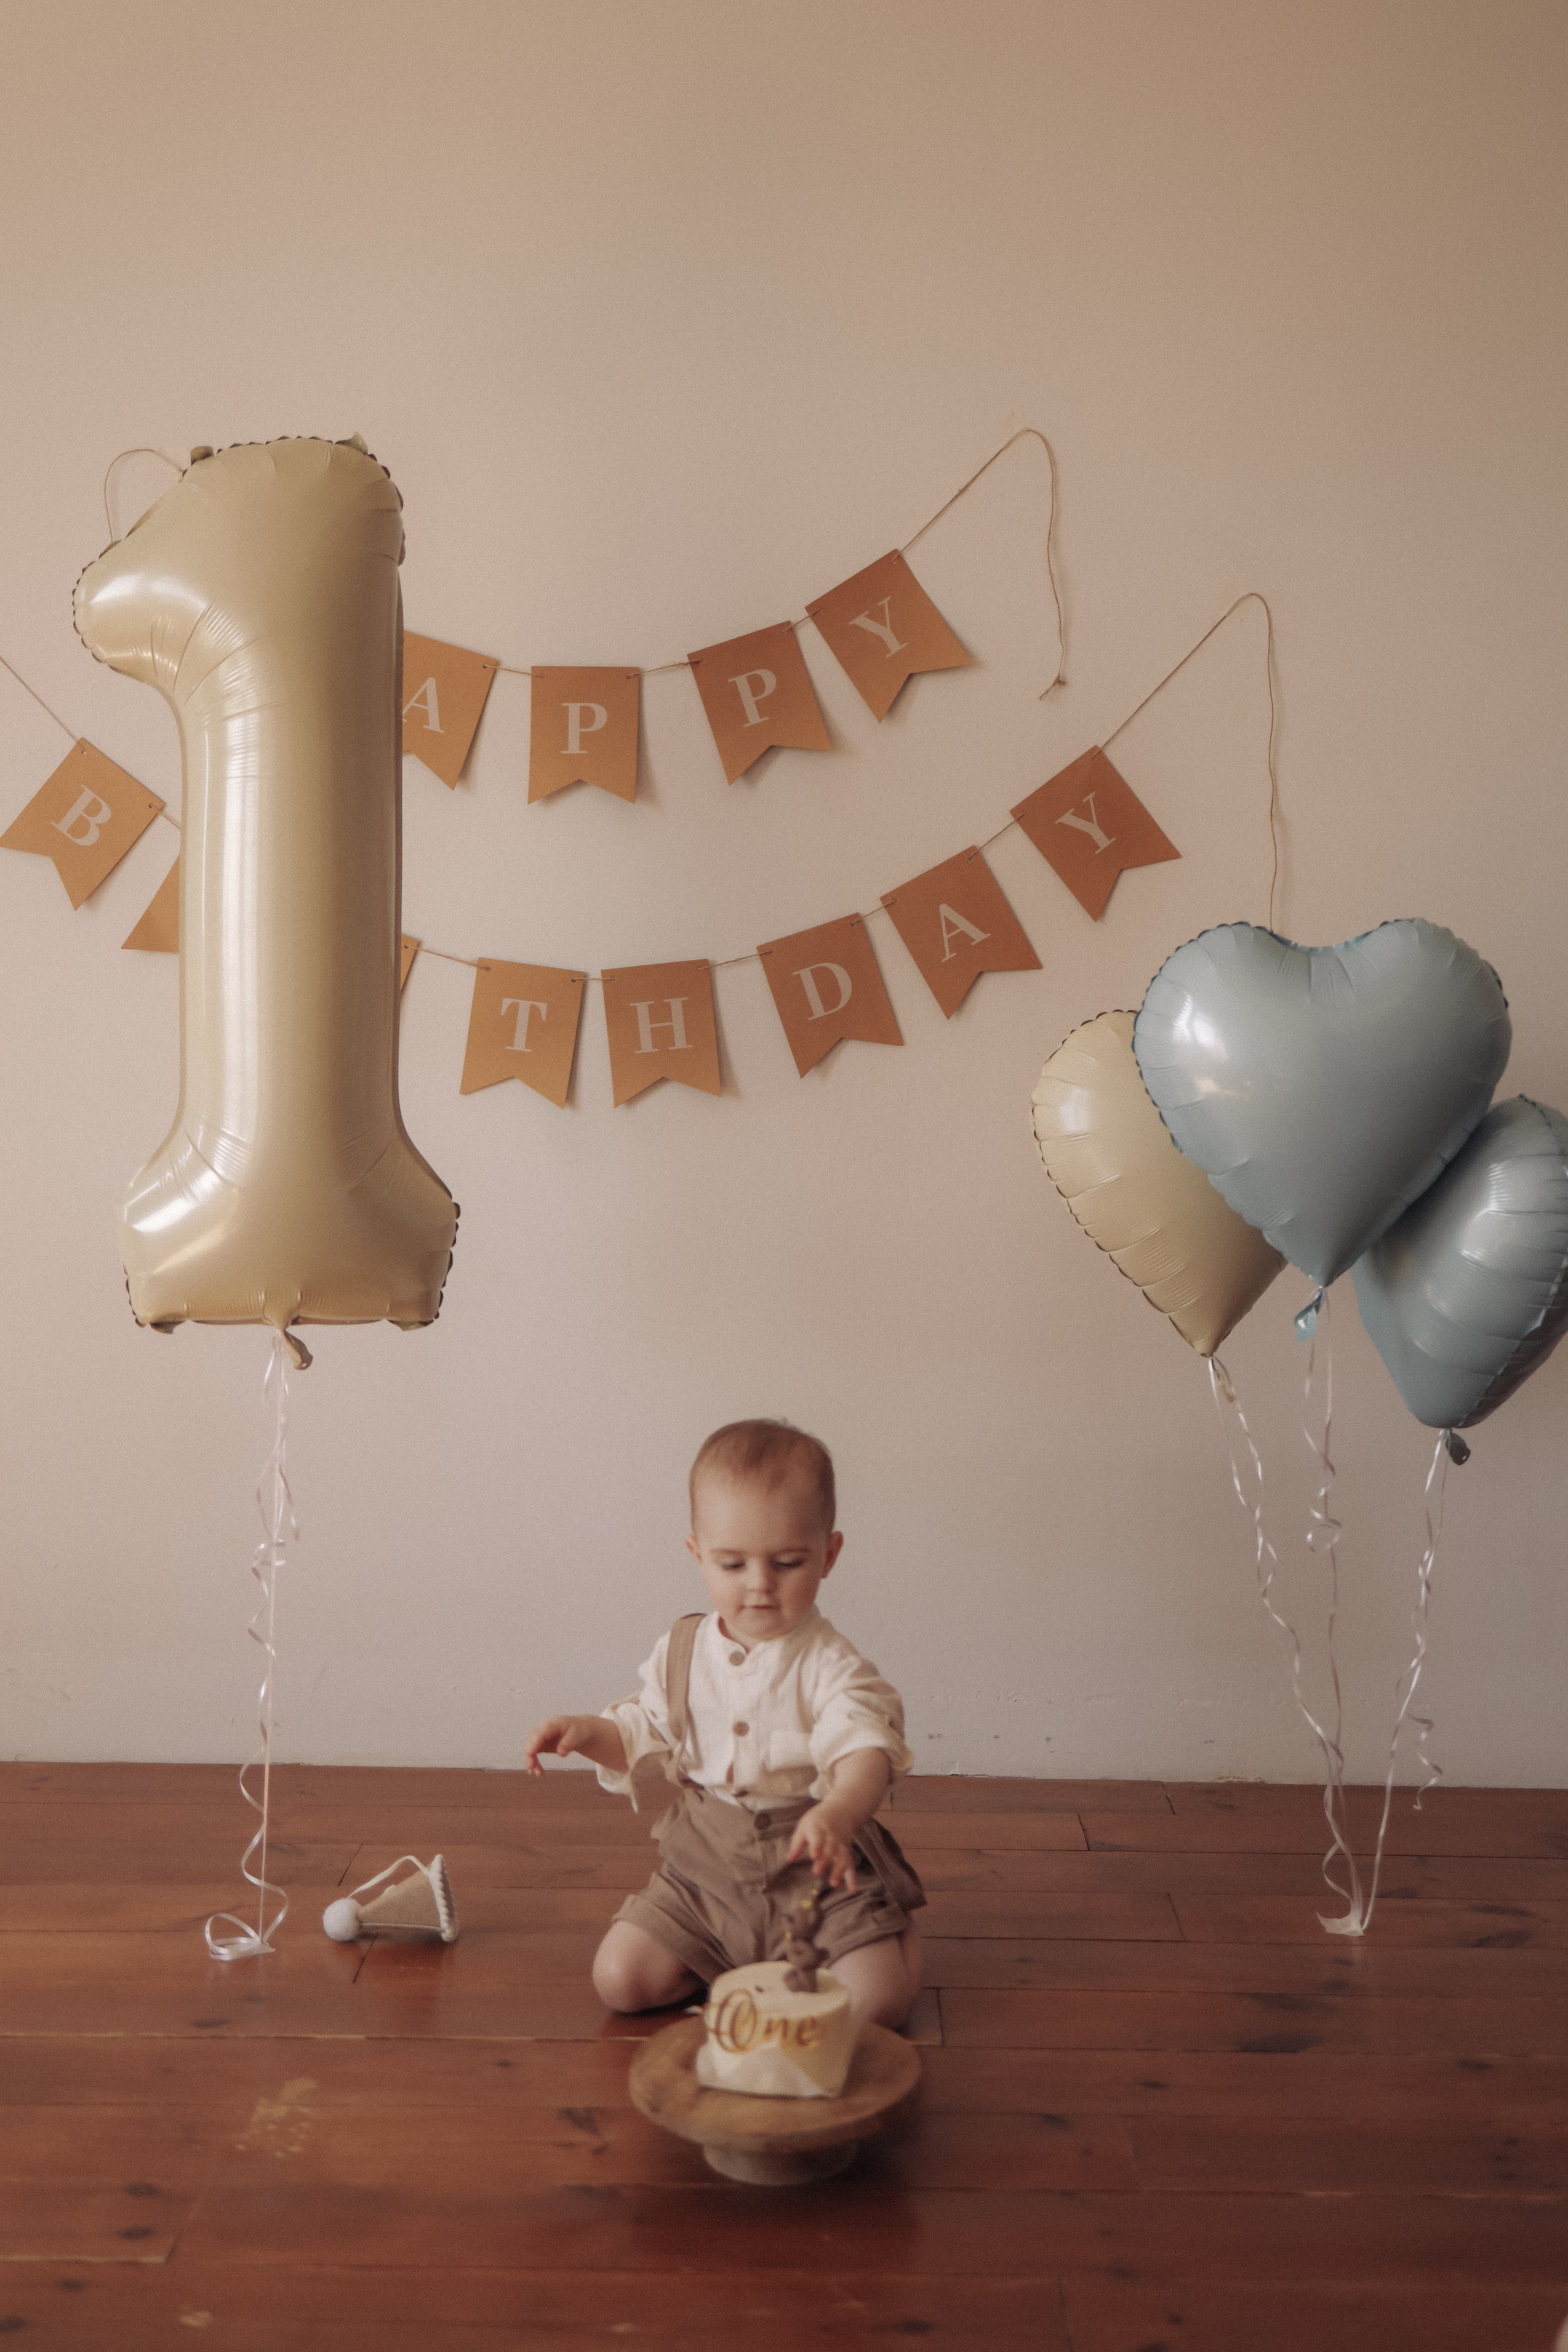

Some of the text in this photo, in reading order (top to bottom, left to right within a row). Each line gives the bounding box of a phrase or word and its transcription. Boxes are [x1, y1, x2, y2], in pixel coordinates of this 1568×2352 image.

[402, 595, 909, 754] APPY
[50, 784, 1117, 1054] BTHDAY
[73, 434, 461, 1332] 1
[707, 1988, 820, 2053] One
